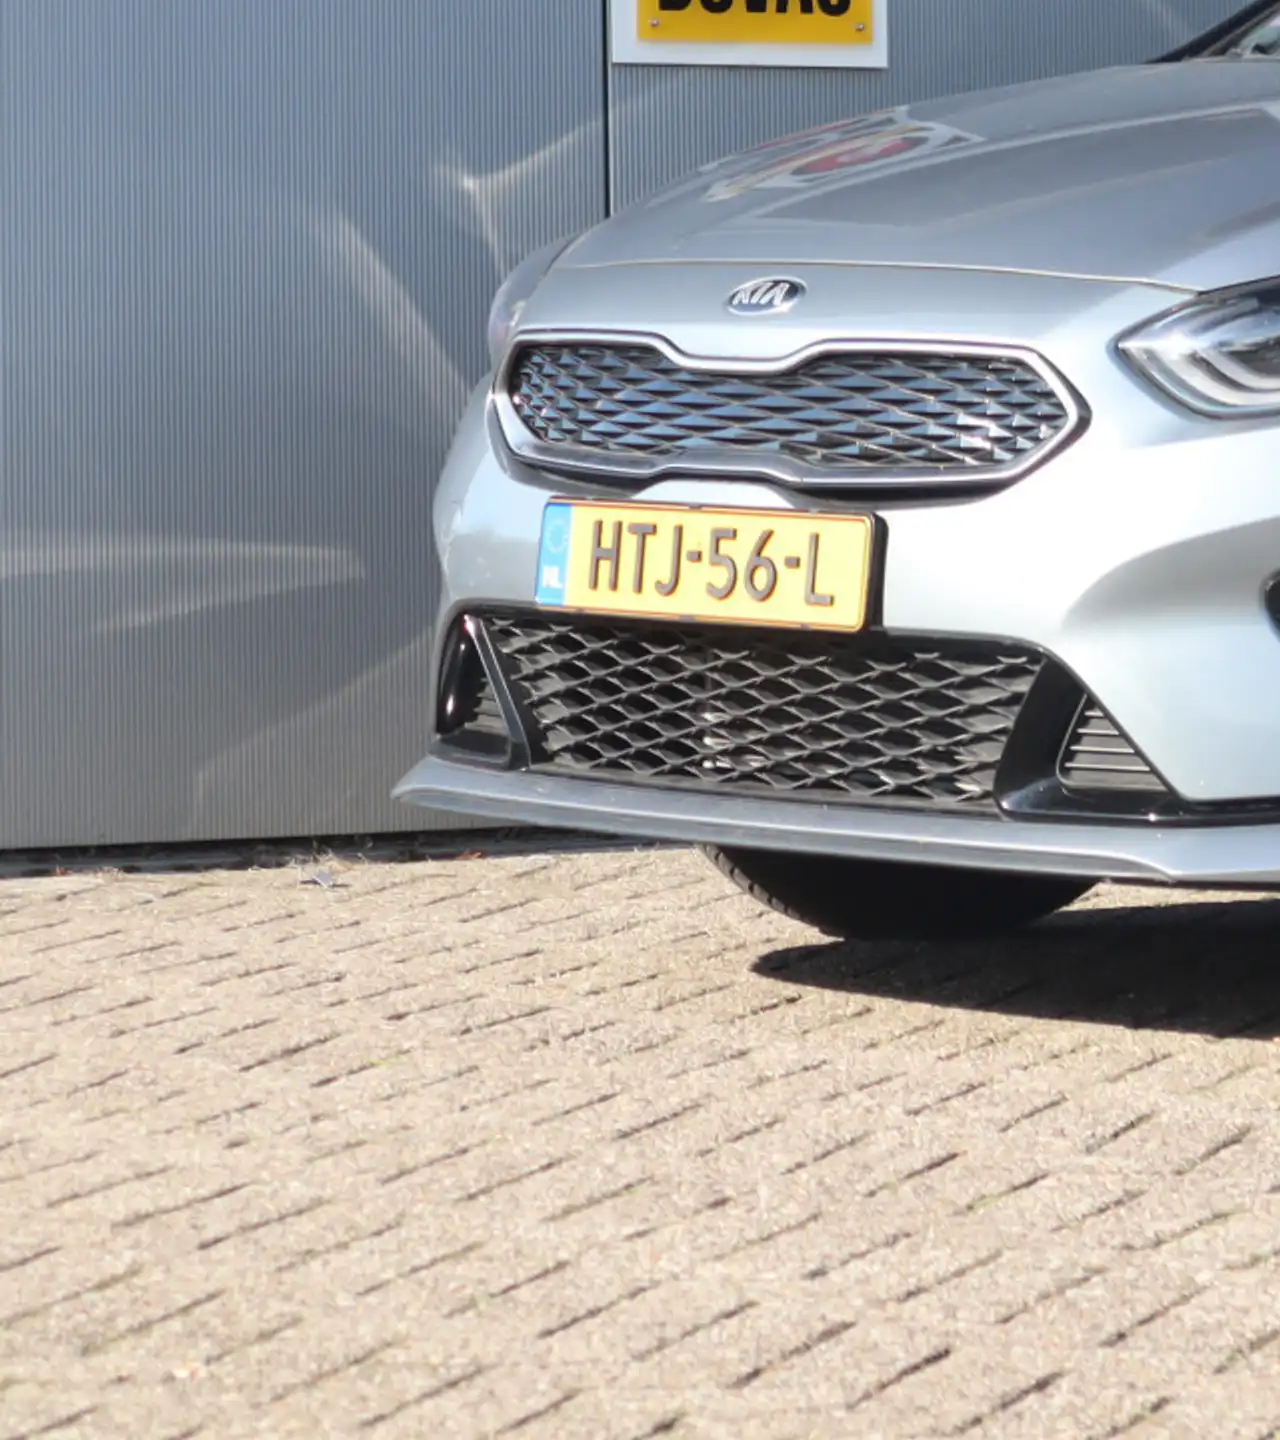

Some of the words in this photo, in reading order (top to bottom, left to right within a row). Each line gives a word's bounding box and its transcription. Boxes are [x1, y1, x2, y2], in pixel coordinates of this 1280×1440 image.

[731, 281, 791, 307] KIA
[588, 519, 835, 607] HTJ-56-L
[541, 565, 563, 590] NL
